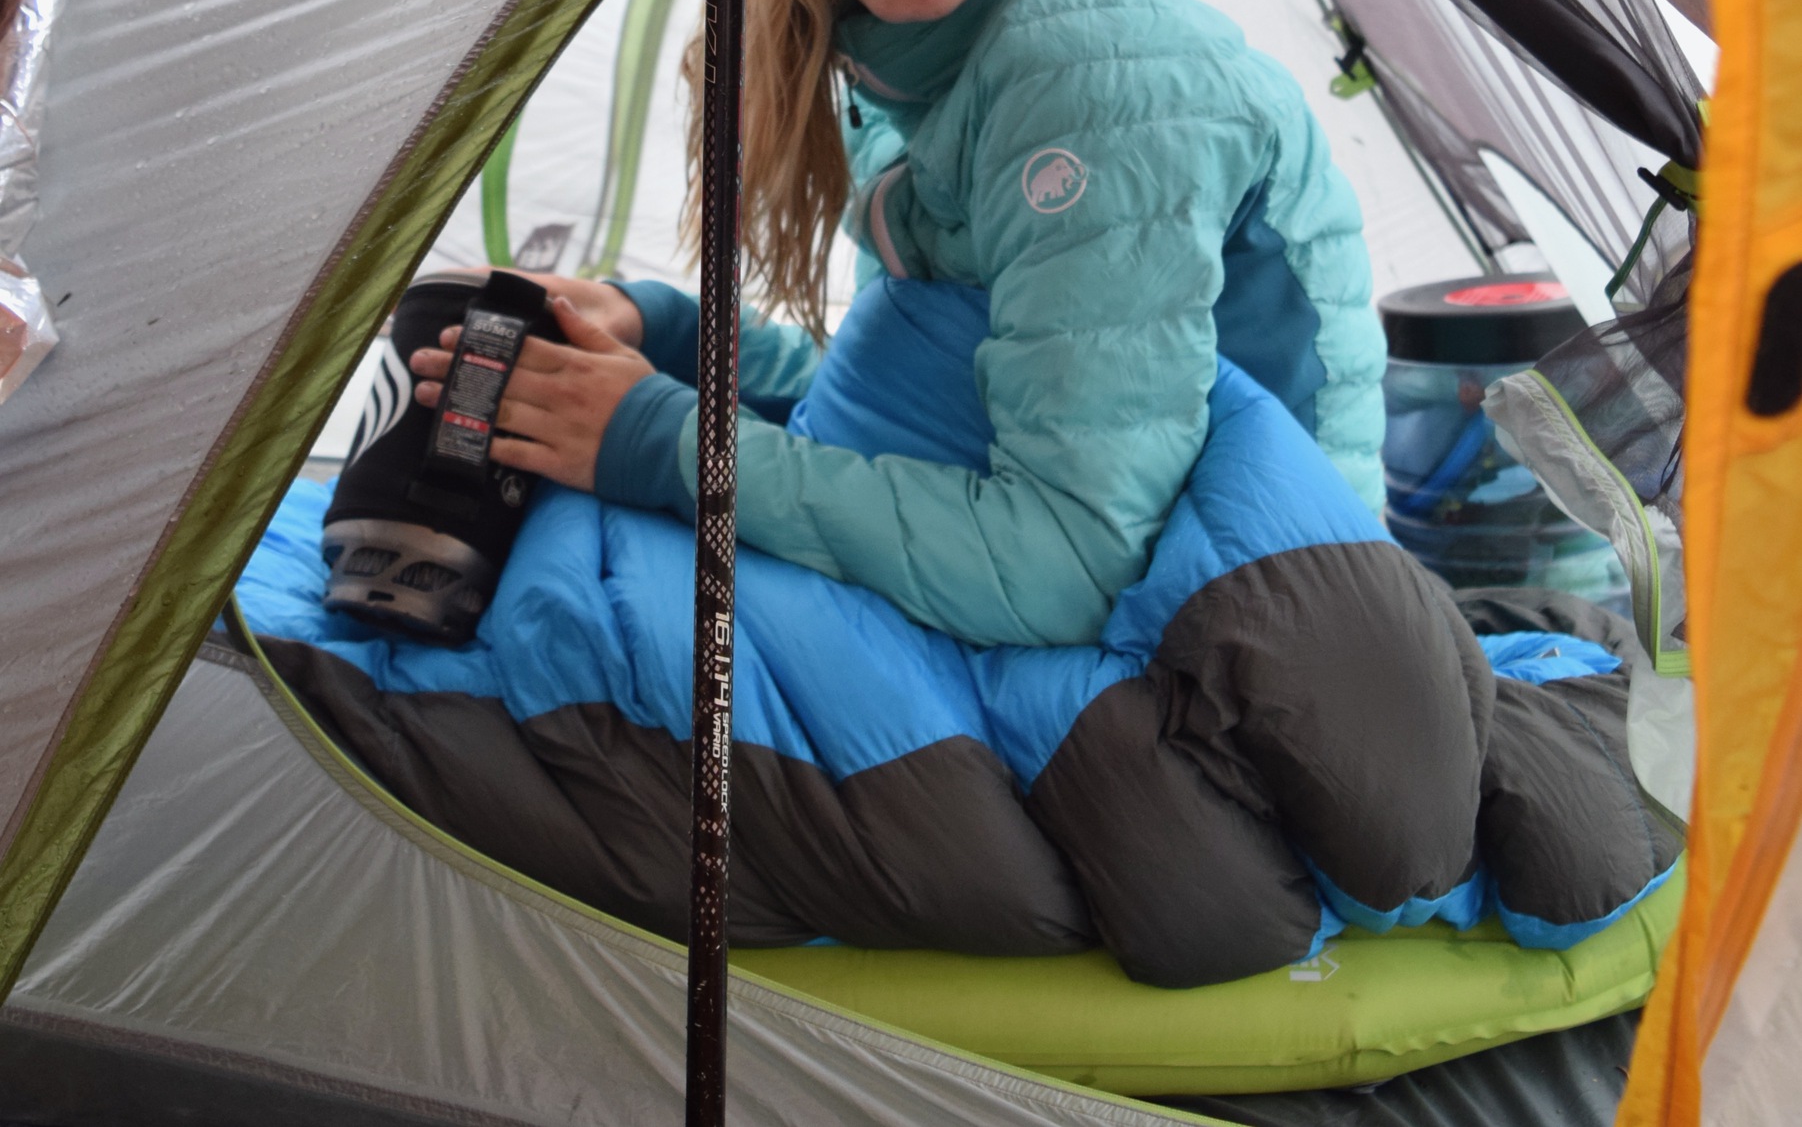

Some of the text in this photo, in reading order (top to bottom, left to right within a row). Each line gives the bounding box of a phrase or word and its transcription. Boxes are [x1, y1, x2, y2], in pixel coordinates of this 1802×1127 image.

[714, 612, 731, 646] 16
[714, 671, 730, 707] 14
[712, 711, 721, 758] VARIO
